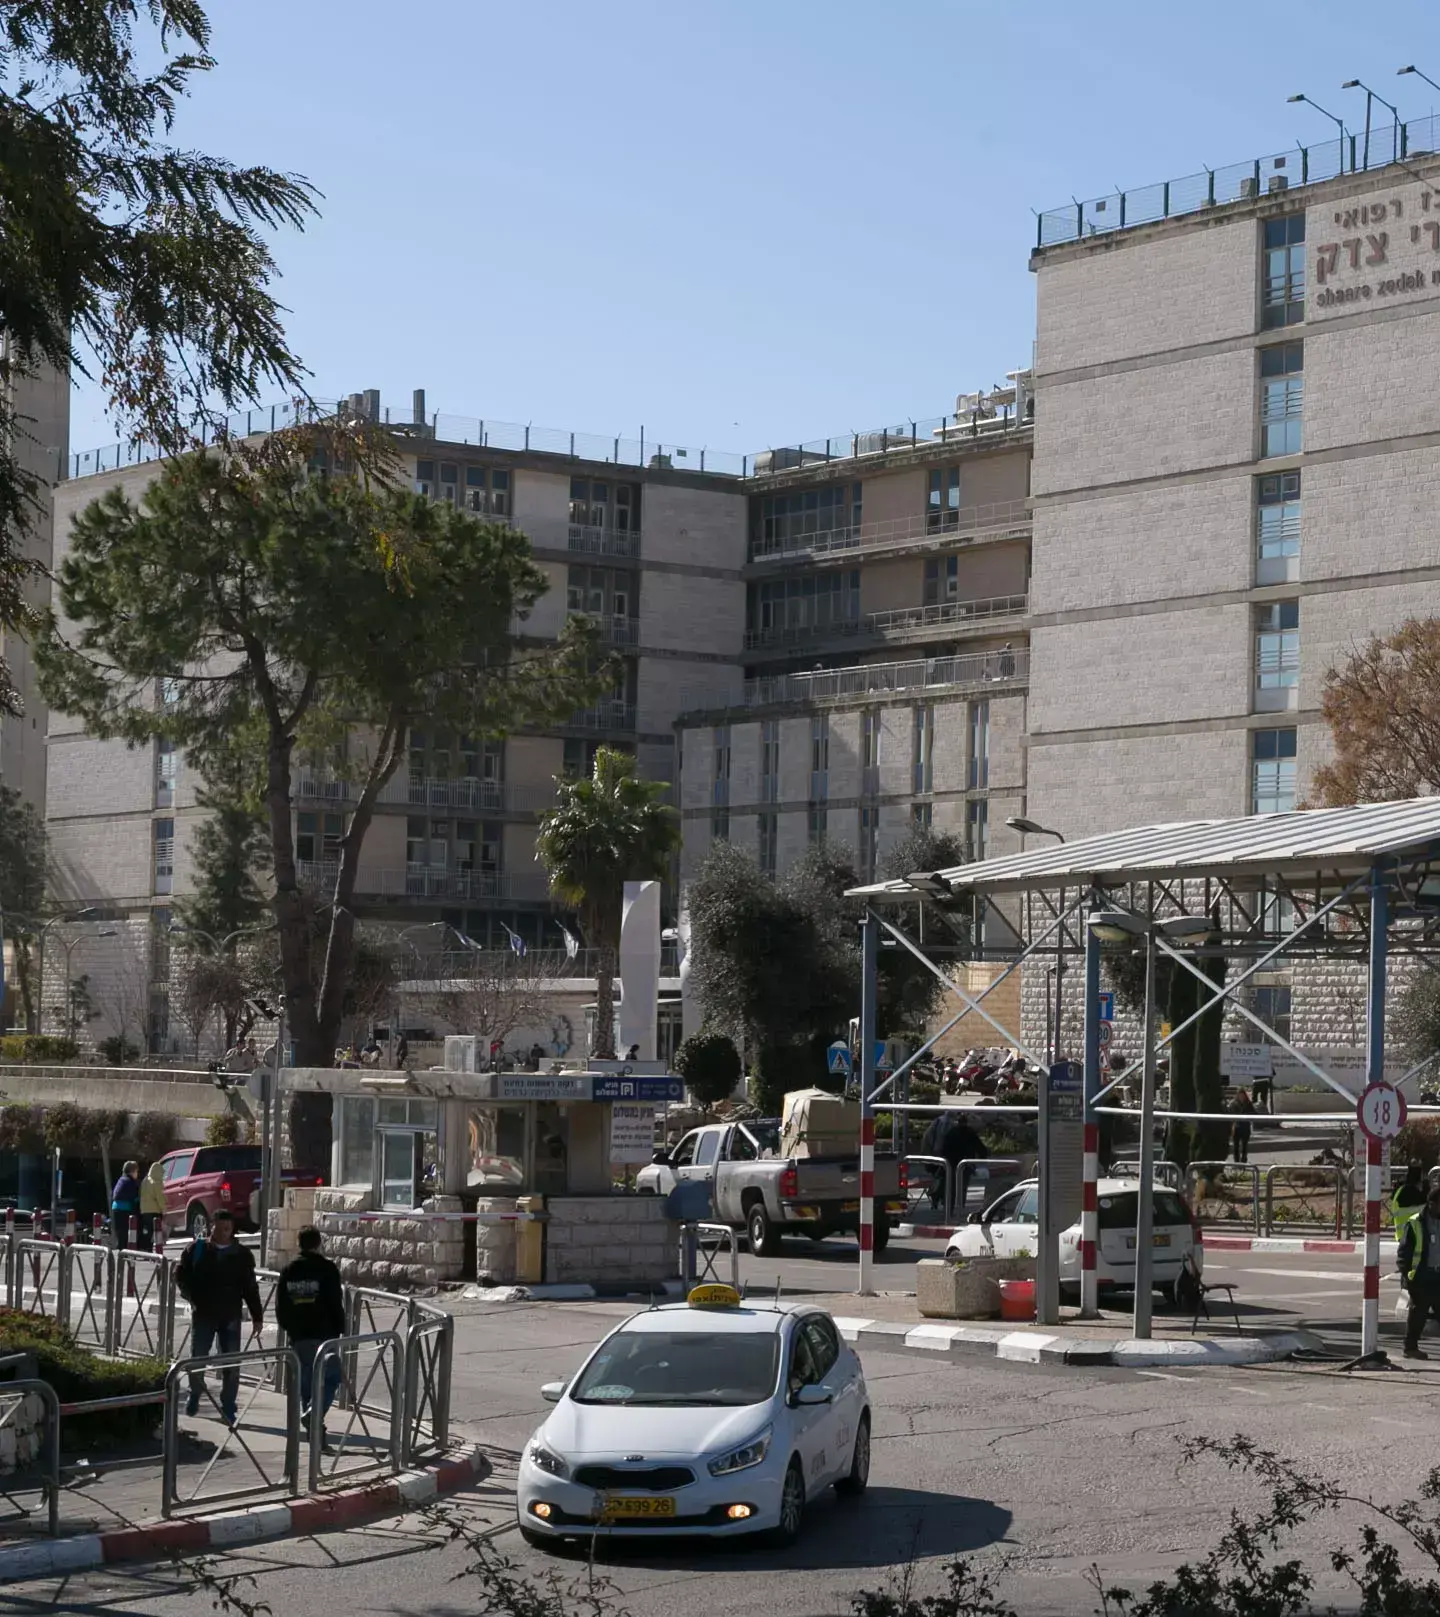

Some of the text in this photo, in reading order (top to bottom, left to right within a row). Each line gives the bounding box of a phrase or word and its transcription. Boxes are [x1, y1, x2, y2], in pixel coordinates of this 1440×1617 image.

[1334, 200, 1403, 229] רפואי
[1316, 231, 1389, 283] צדק
[1316, 285, 1370, 307] shaare
[1377, 269, 1426, 297] zedek
